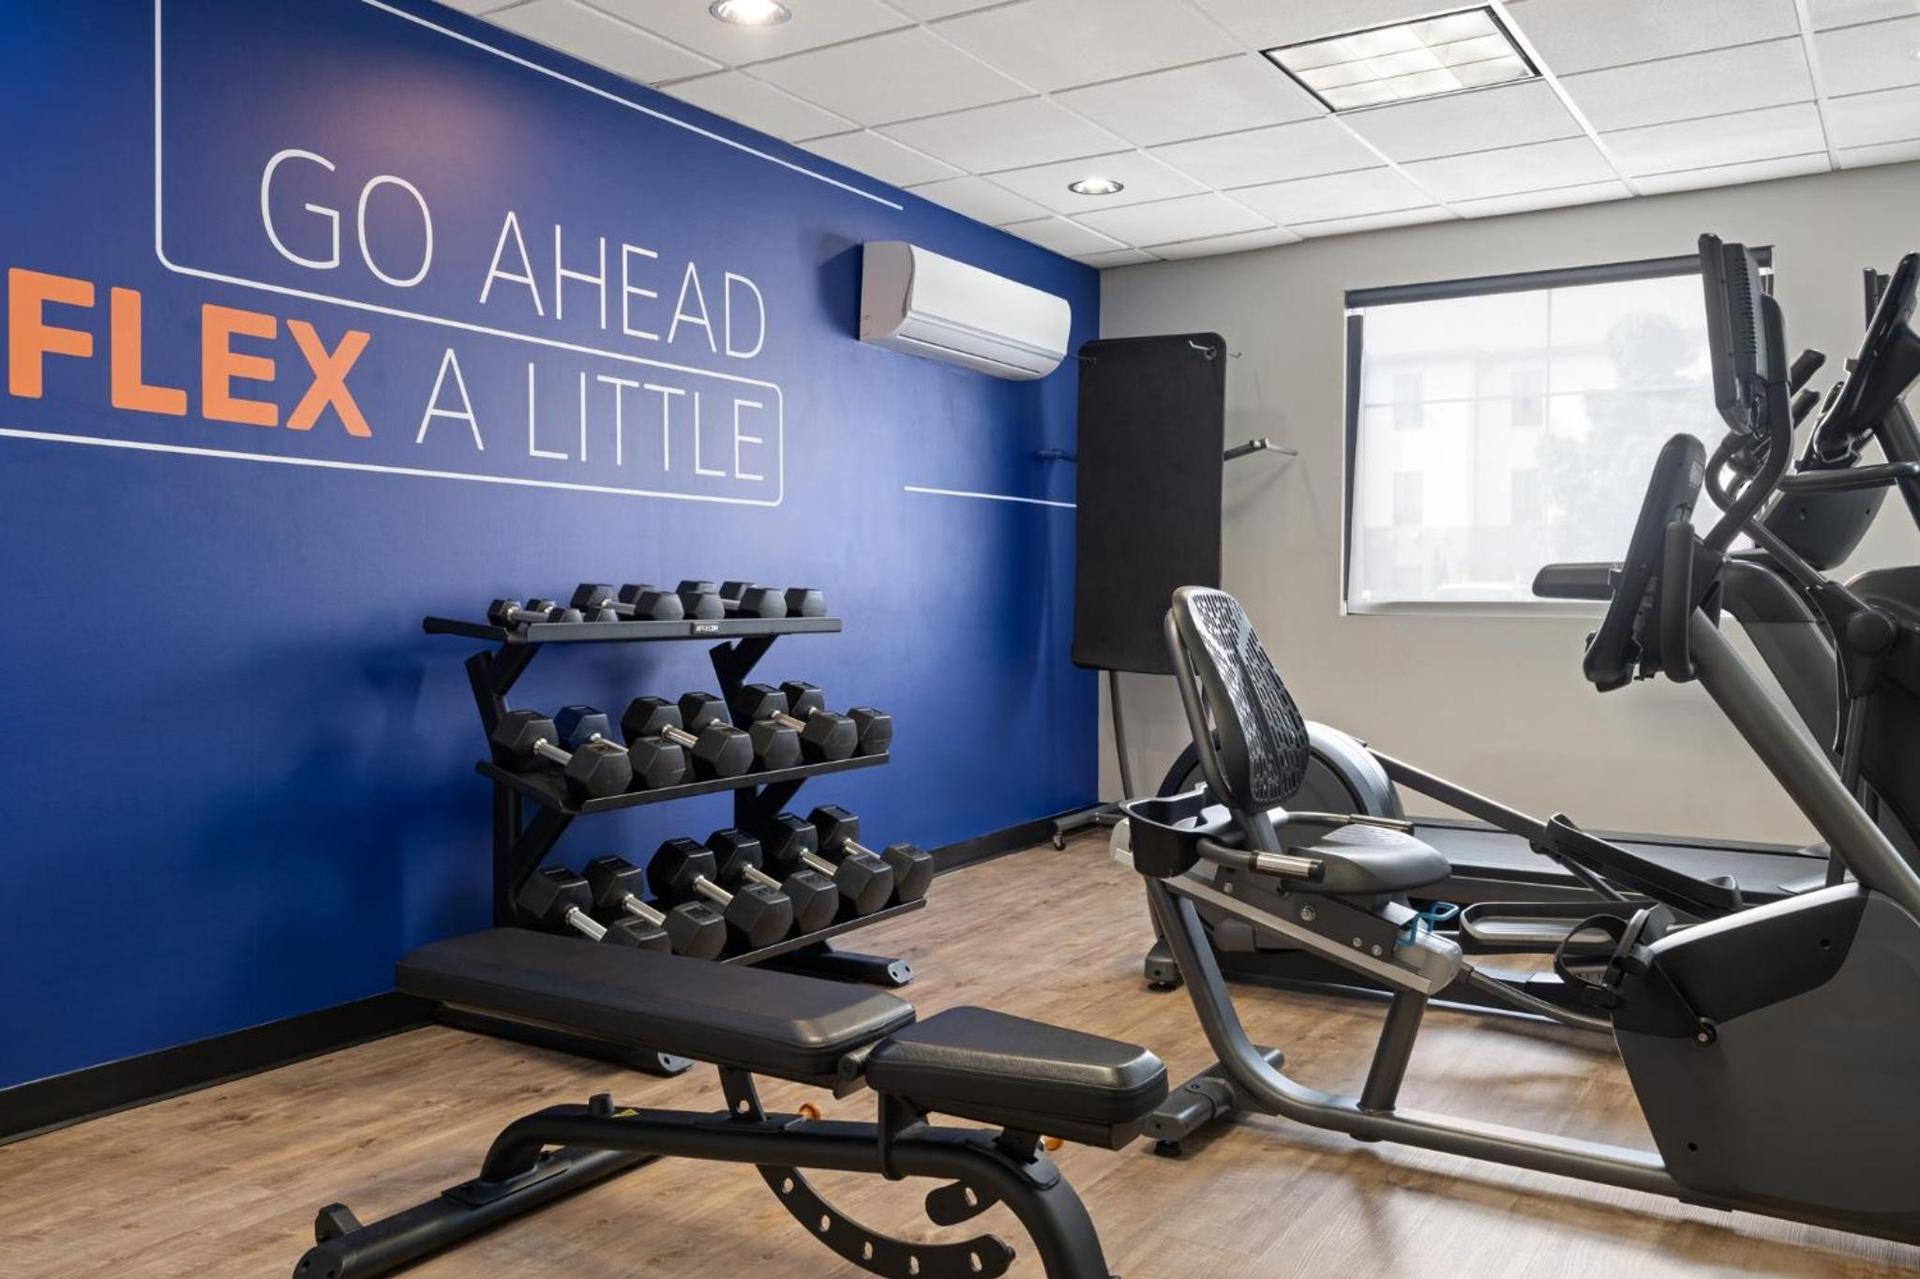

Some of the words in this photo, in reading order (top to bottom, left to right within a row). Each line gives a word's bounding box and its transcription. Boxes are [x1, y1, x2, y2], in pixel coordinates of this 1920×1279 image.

[260, 148, 434, 288] GO
[479, 211, 766, 359] AHEAD
[9, 268, 372, 437] FLEX
[416, 348, 485, 451] A
[529, 363, 763, 481] LITTLE
